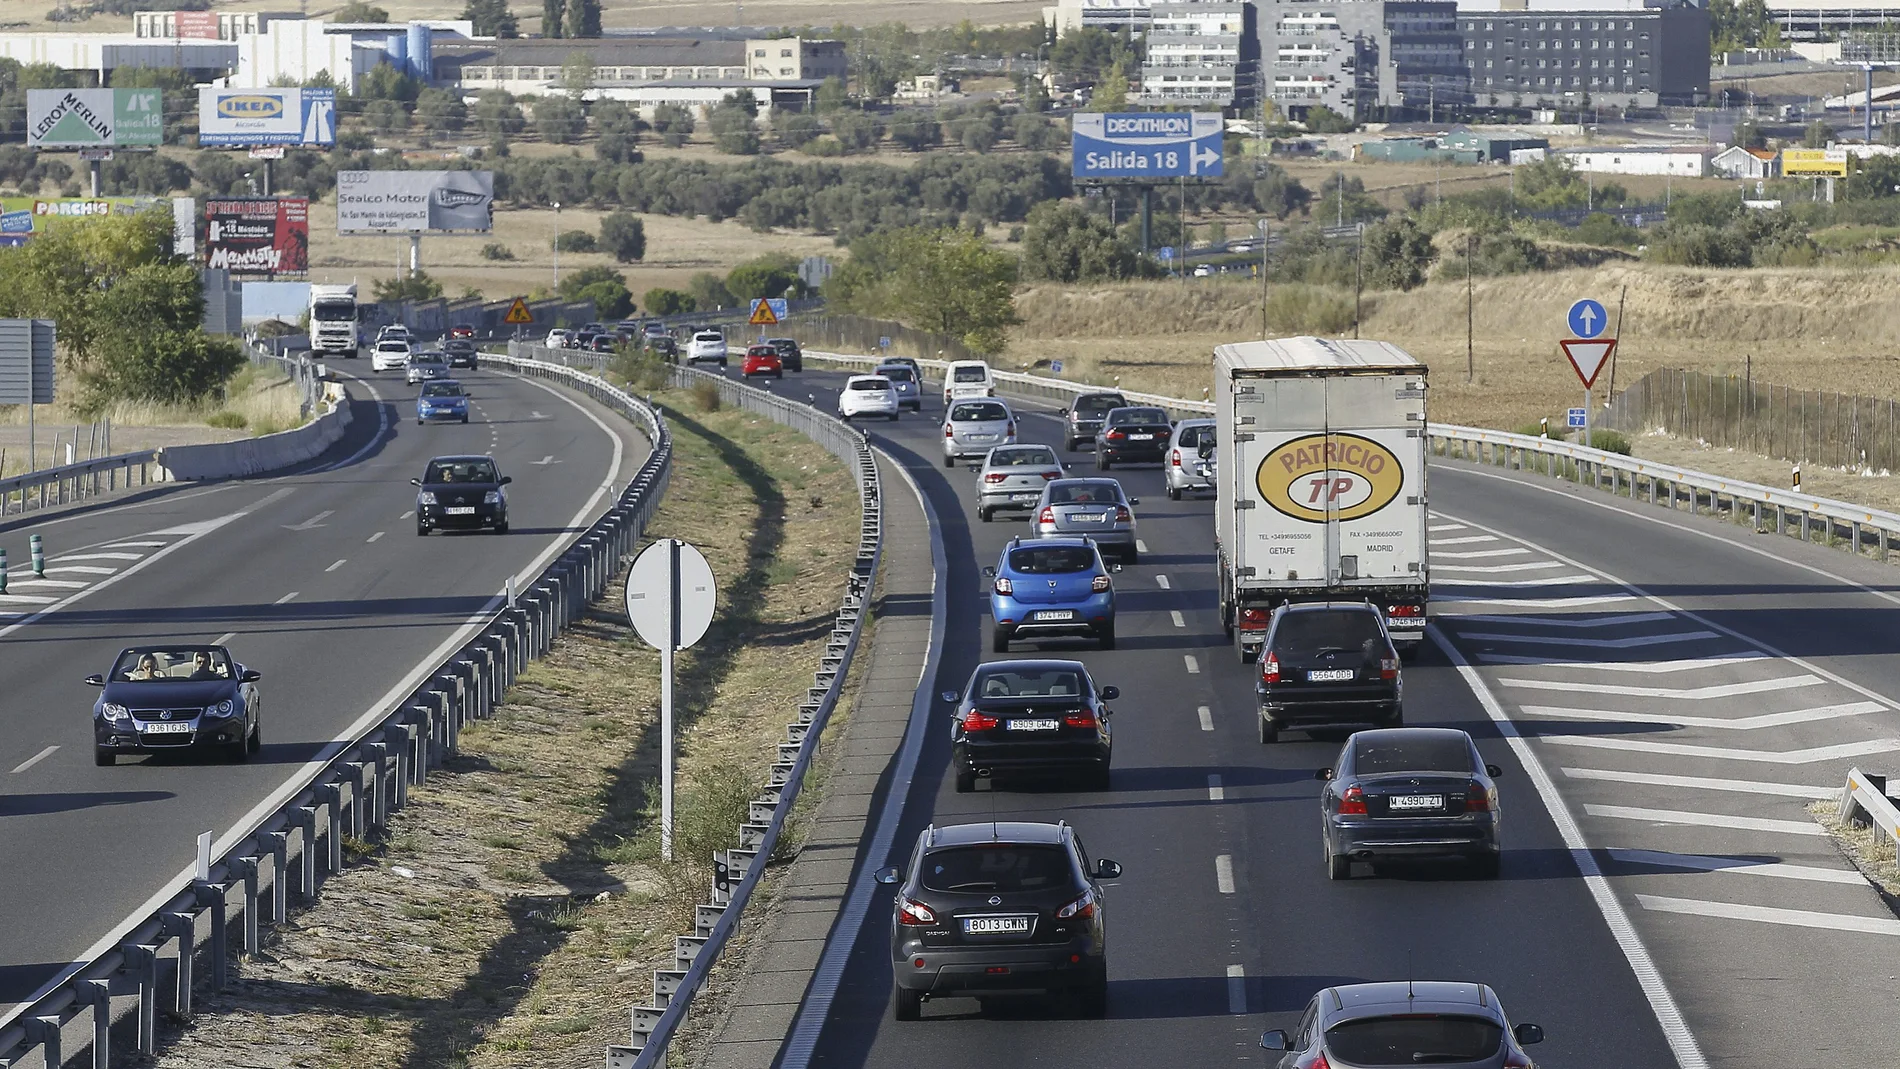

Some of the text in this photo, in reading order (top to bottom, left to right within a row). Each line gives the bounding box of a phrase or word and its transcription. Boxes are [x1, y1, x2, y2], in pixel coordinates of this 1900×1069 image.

[226, 102, 275, 111] IKEA
[30, 92, 112, 140] LEROY MERLIN
[115, 113, 161, 128] Salida 18
[1107, 118, 1189, 133] DECATHLON
[1085, 151, 1179, 169] Salida 18
[339, 193, 428, 204] Sealco Motor
[1280, 442, 1385, 475] PATRICIO
[1308, 478, 1354, 503] TP
[1269, 547, 1296, 555] GETAFE
[1366, 544, 1394, 552] MADRID
[1313, 671, 1334, 680] 5564
[150, 723, 187, 733] 9361 GJS
[1013, 719, 1034, 729] 6909
[972, 918, 1025, 931] 8013 GWN
